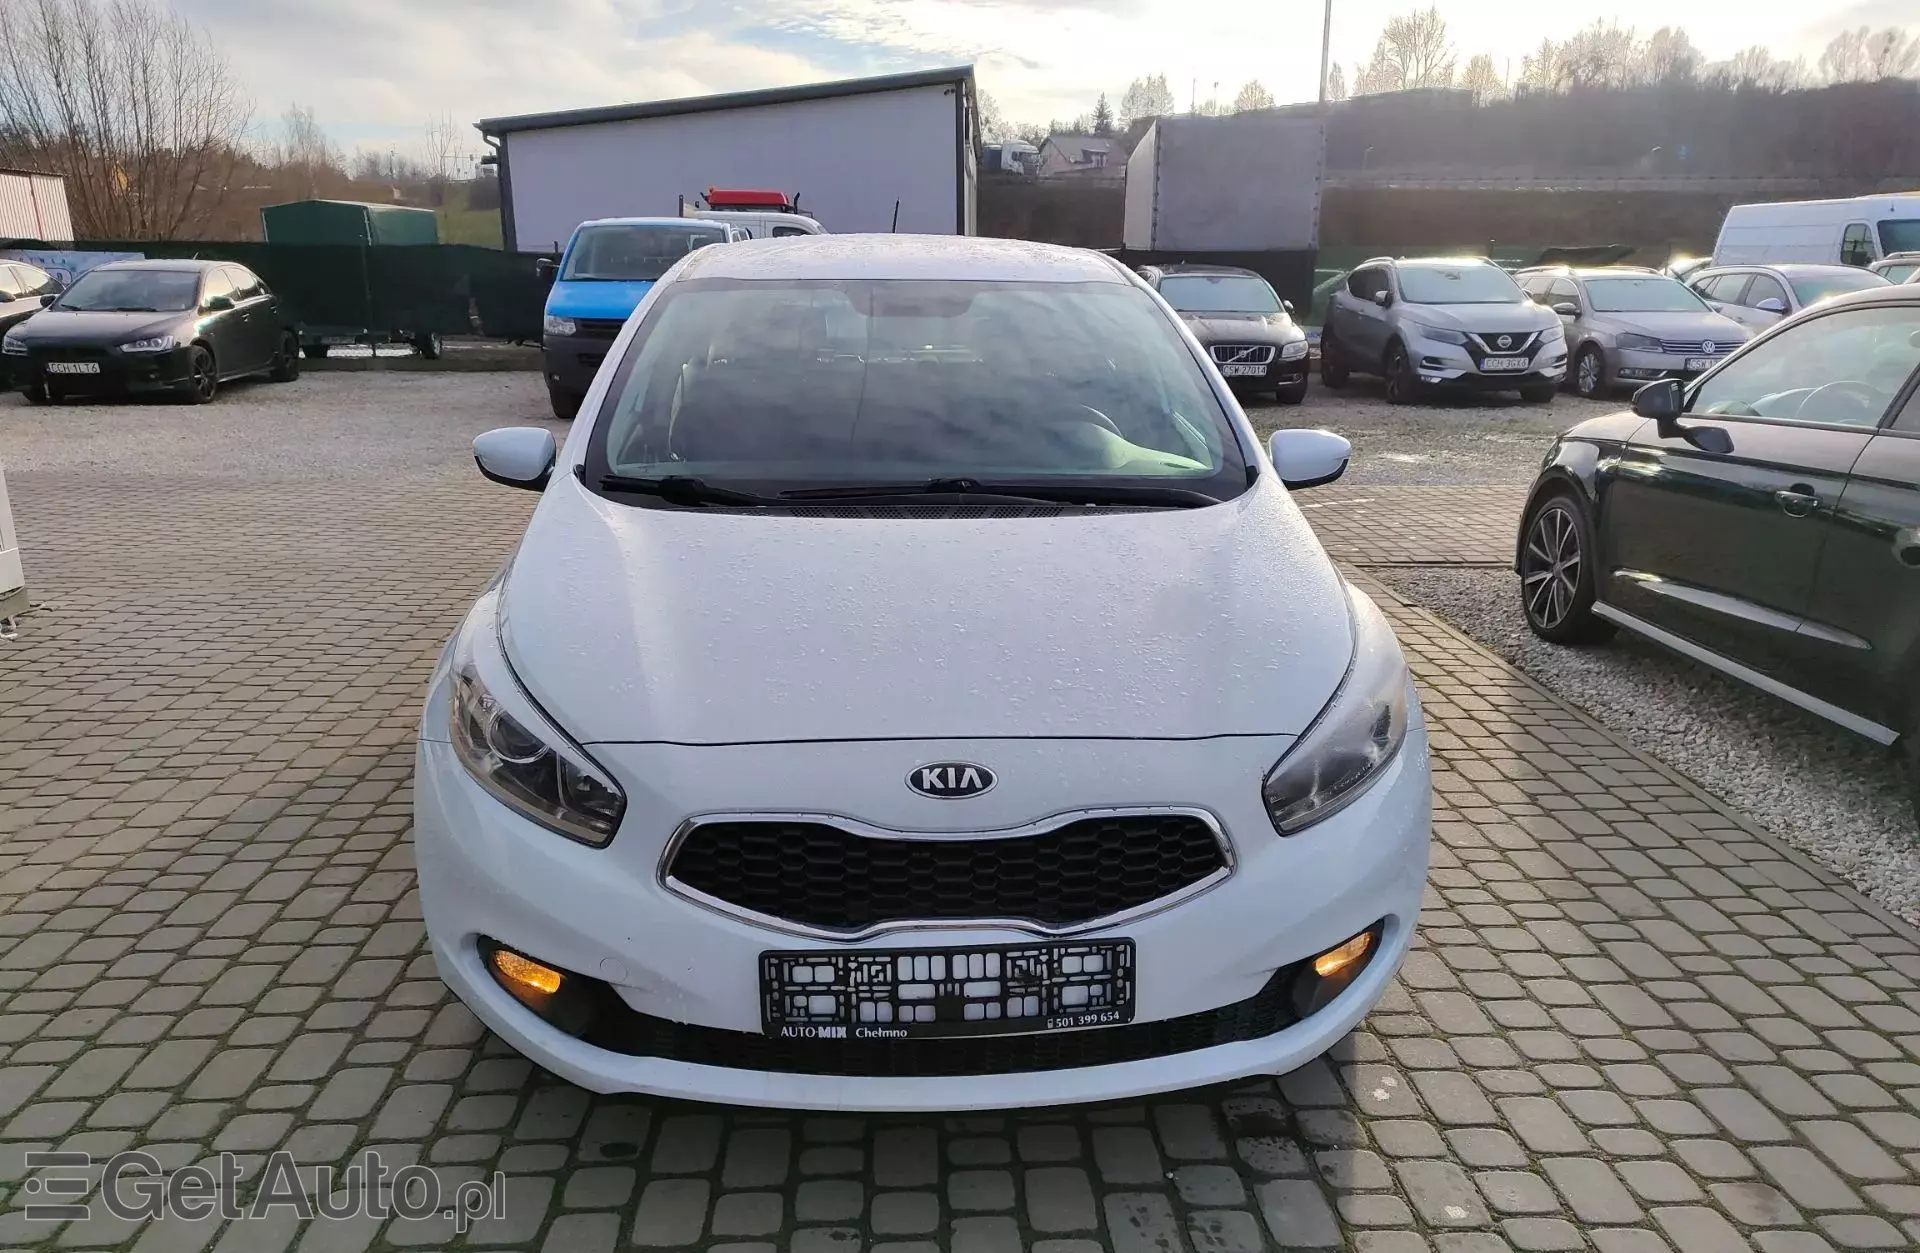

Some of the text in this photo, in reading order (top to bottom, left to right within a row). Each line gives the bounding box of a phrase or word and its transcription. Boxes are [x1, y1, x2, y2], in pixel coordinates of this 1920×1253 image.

[920, 767, 983, 789] KIA
[1055, 1011, 1120, 1028] 501 399 654
[855, 1027, 907, 1038] Chełmno
